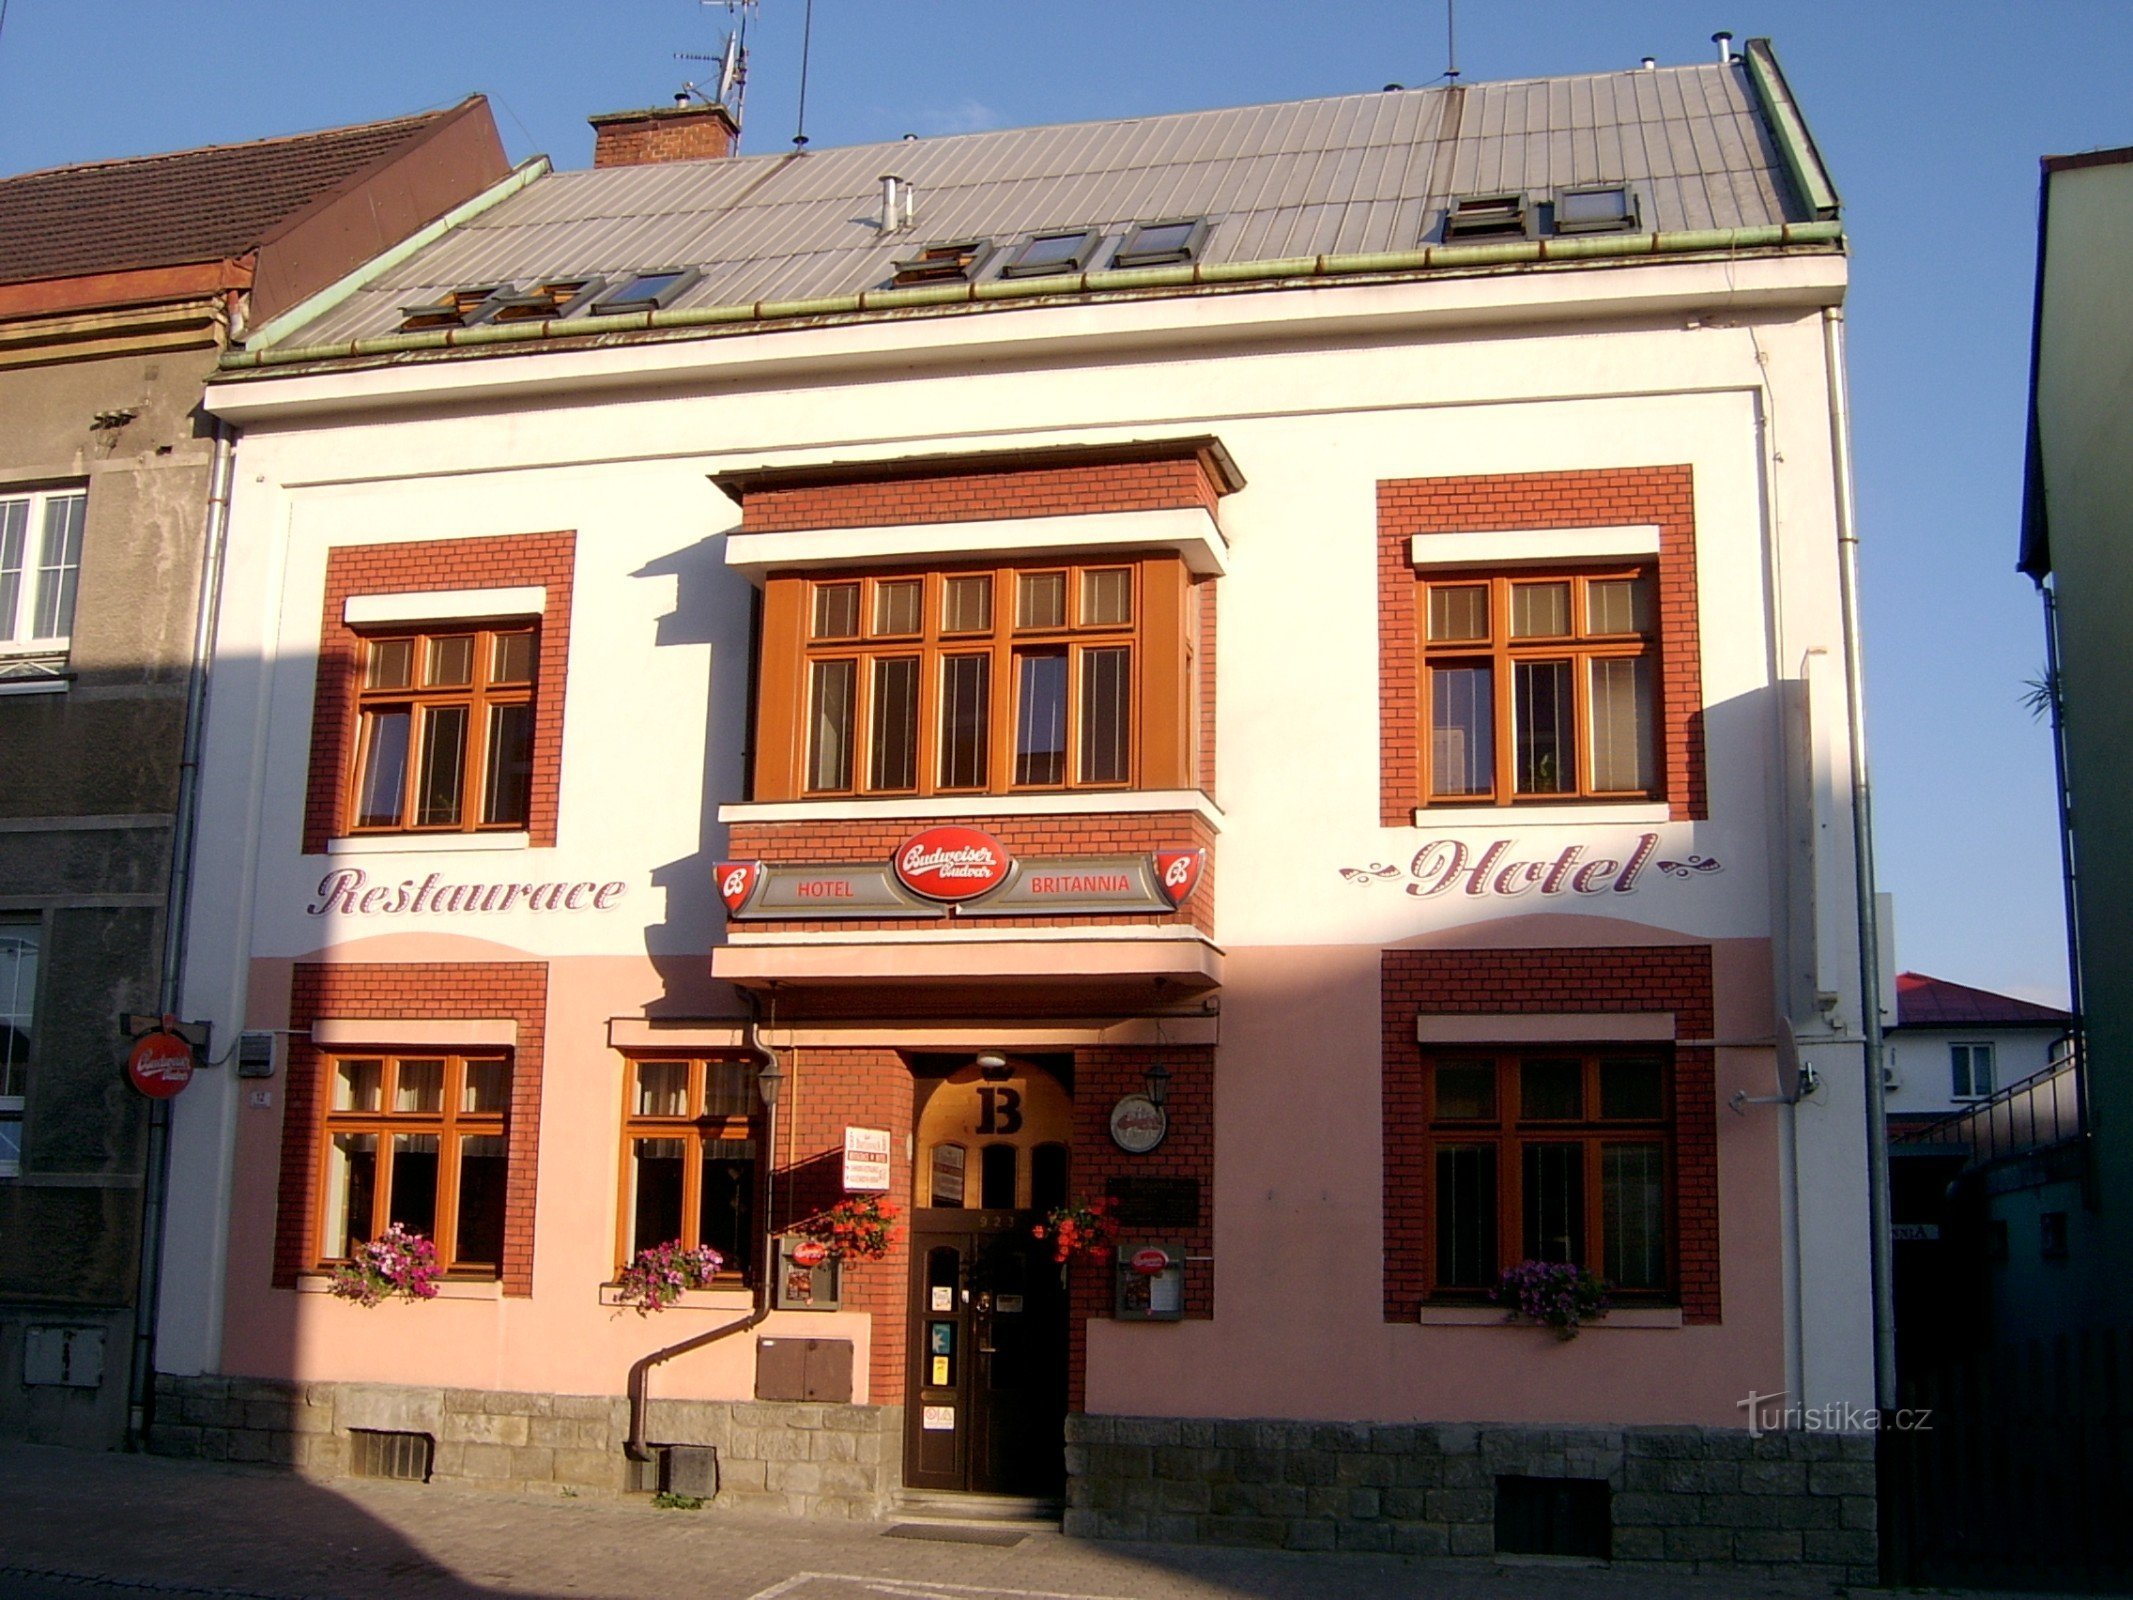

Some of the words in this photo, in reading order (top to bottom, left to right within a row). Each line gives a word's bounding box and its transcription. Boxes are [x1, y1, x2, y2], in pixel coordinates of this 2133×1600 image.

[903, 844, 996, 873] Budweiser
[939, 862, 993, 878] Budvar
[1405, 832, 1659, 896] Hotel
[307, 867, 627, 916] Restaurace
[797, 881, 854, 898] HOTEL
[1031, 875, 1130, 894] BRITANNIA
[975, 1086, 1023, 1135] B
